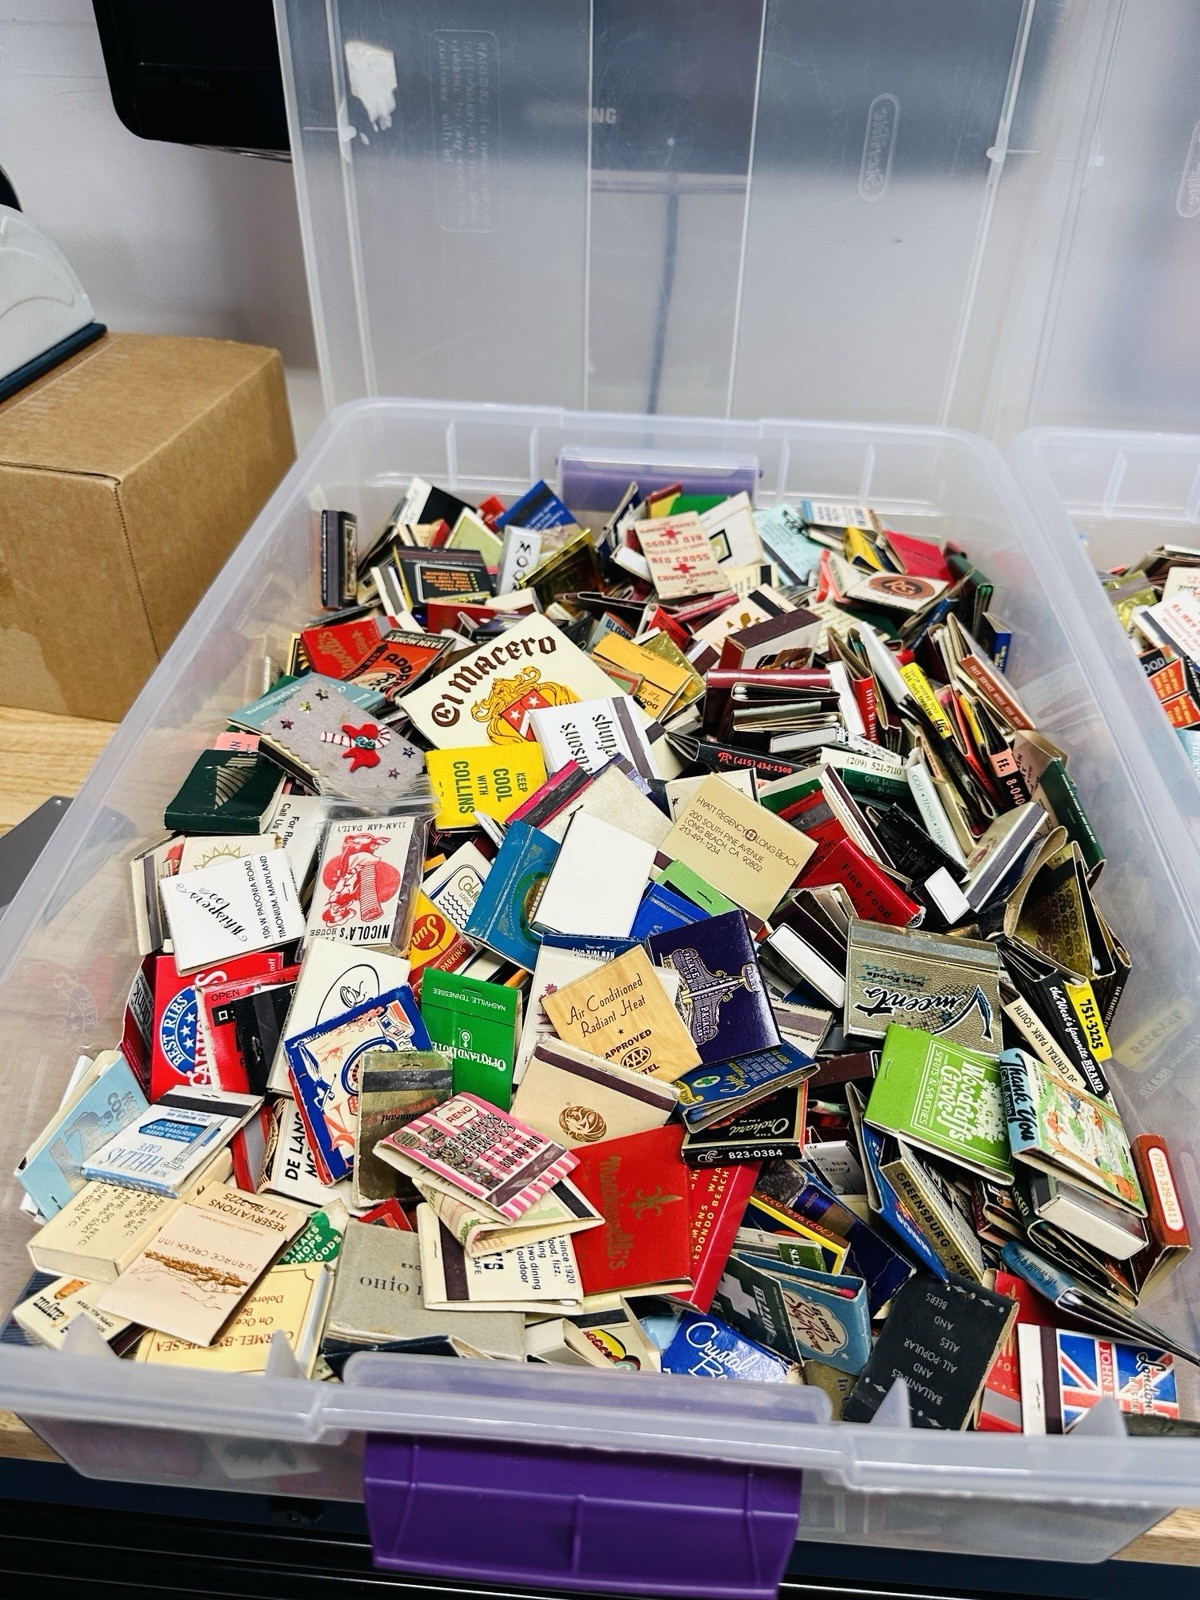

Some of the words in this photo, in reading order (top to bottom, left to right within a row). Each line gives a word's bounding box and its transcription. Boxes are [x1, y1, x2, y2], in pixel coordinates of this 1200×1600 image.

[652, 556, 674, 564] RED
[676, 554, 710, 563] CROSS
[386, 635, 420, 647] MONEY
[425, 640, 442, 649] EARN
[969, 664, 981, 677] FAST
[977, 674, 995, 693] SERVICE
[903, 672, 912, 682] SEE
[909, 683, 920, 695] THIS
[917, 695, 932, 717] EMBLEM
[558, 719, 594, 779] eason's
[586, 710, 624, 761] etings
[734, 757, 756, 768] (415)
[846, 756, 868, 768] (209)
[871, 761, 902, 775] 521-7110
[453, 760, 476, 814] COLLINS
[477, 774, 489, 796] WITH
[493, 768, 513, 803] COOL
[516, 772, 528, 793] KEEP
[277, 802, 291, 818] Call
[912, 774, 923, 792] GOLF
[923, 799, 936, 823] TENNIS
[272, 818, 283, 831] Us
[286, 815, 299, 830] For
[336, 823, 363, 832] DAILY
[688, 809, 703, 820] 200
[701, 816, 725, 835] SOUTH
[723, 829, 741, 844] PINE
[738, 837, 765, 863] AVENUE
[696, 796, 717, 813] HYATT
[717, 809, 747, 835] REGENCY
[755, 835, 777, 855] LONG
[774, 848, 799, 870] BEACH
[679, 825, 721, 855] 213-491-1234
[684, 817, 705, 833] LONG
[703, 828, 729, 850] BEACH,
[728, 845, 740, 858] CA
[742, 854, 763, 873] 90802
[244, 860, 256, 880] ROAD
[260, 855, 274, 896] MARYLAND
[249, 881, 263, 915] PADONIA
[840, 863, 864, 889] Fine
[864, 889, 893, 920] Food
[190, 892, 248, 942] Whispers
[258, 915, 266, 925] W
[271, 896, 286, 938] TIMONIUM,
[260, 925, 270, 939] 106
[310, 928, 336, 937] HOUSE
[339, 924, 390, 940] NICOLA'S
[411, 915, 444, 951] Sun
[441, 947, 466, 972] PARKING
[211, 989, 240, 1002] OPEN
[432, 987, 470, 1000] TENNESSEE
[566, 1006, 585, 1026] Air
[586, 973, 643, 1012] Conditioned
[1048, 984, 1062, 1001] the
[164, 996, 188, 1029] RIBS
[581, 1010, 618, 1038] Radiant
[621, 996, 646, 1018] Heat
[700, 1005, 712, 1036] PALACE
[1013, 1004, 1035, 1032] SOUTH
[1054, 996, 1075, 1026] West's
[1078, 999, 1104, 1049] 751-3225
[162, 1030, 184, 1067] BEST
[604, 1028, 652, 1060] APPROVED
[1030, 1027, 1049, 1047] PARK
[1063, 1023, 1088, 1059] favorite
[456, 1050, 507, 1072] OPRYLAND
[622, 1049, 650, 1068] AAA
[932, 1050, 943, 1075] SPIRITS
[1045, 1046, 1071, 1075] CENTRAL
[1079, 1056, 1105, 1094] BRAND
[920, 1083, 935, 1125] SAVORIES
[1004, 1089, 1017, 1122] Again
[1006, 1052, 1029, 1104] Thank
[1020, 1102, 1037, 1141] You
[446, 1105, 472, 1124] RENO
[729, 1118, 790, 1136] Orchard
[98, 1144, 163, 1175] HELLAS
[484, 1148, 502, 1162] HOTEL
[1152, 1152, 1167, 1181] (702)
[285, 1159, 299, 1180] DE
[712, 1170, 730, 1208] BEACH
[208, 1200, 287, 1233] RESERVATIONS
[896, 1172, 950, 1249] GREENSBURG
[1157, 1181, 1180, 1228] 329-0411
[281, 1223, 320, 1263] STEAKS
[289, 1232, 323, 1266] CHOPS
[303, 1247, 318, 1262] and
[526, 1245, 536, 1261] two
[546, 1237, 559, 1256] ood,
[558, 1239, 570, 1262] since
[515, 1249, 530, 1284] outdoor
[528, 1261, 543, 1290] dining
[550, 1258, 564, 1277] fizz,
[563, 1263, 576, 1284] 1920
[360, 1276, 409, 1293] OHIO
[249, 1294, 284, 1304] Dolore
[926, 1293, 948, 1309] BEERS
[259, 1316, 274, 1326] On
[934, 1316, 954, 1331] AND
[686, 1321, 756, 1376] Crystal
[903, 1337, 939, 1364] POPULAR
[940, 1336, 960, 1353] ALES
[913, 1363, 933, 1379] AND
[942, 1360, 958, 1374] ALL
[1100, 1347, 1115, 1394] JOHN
